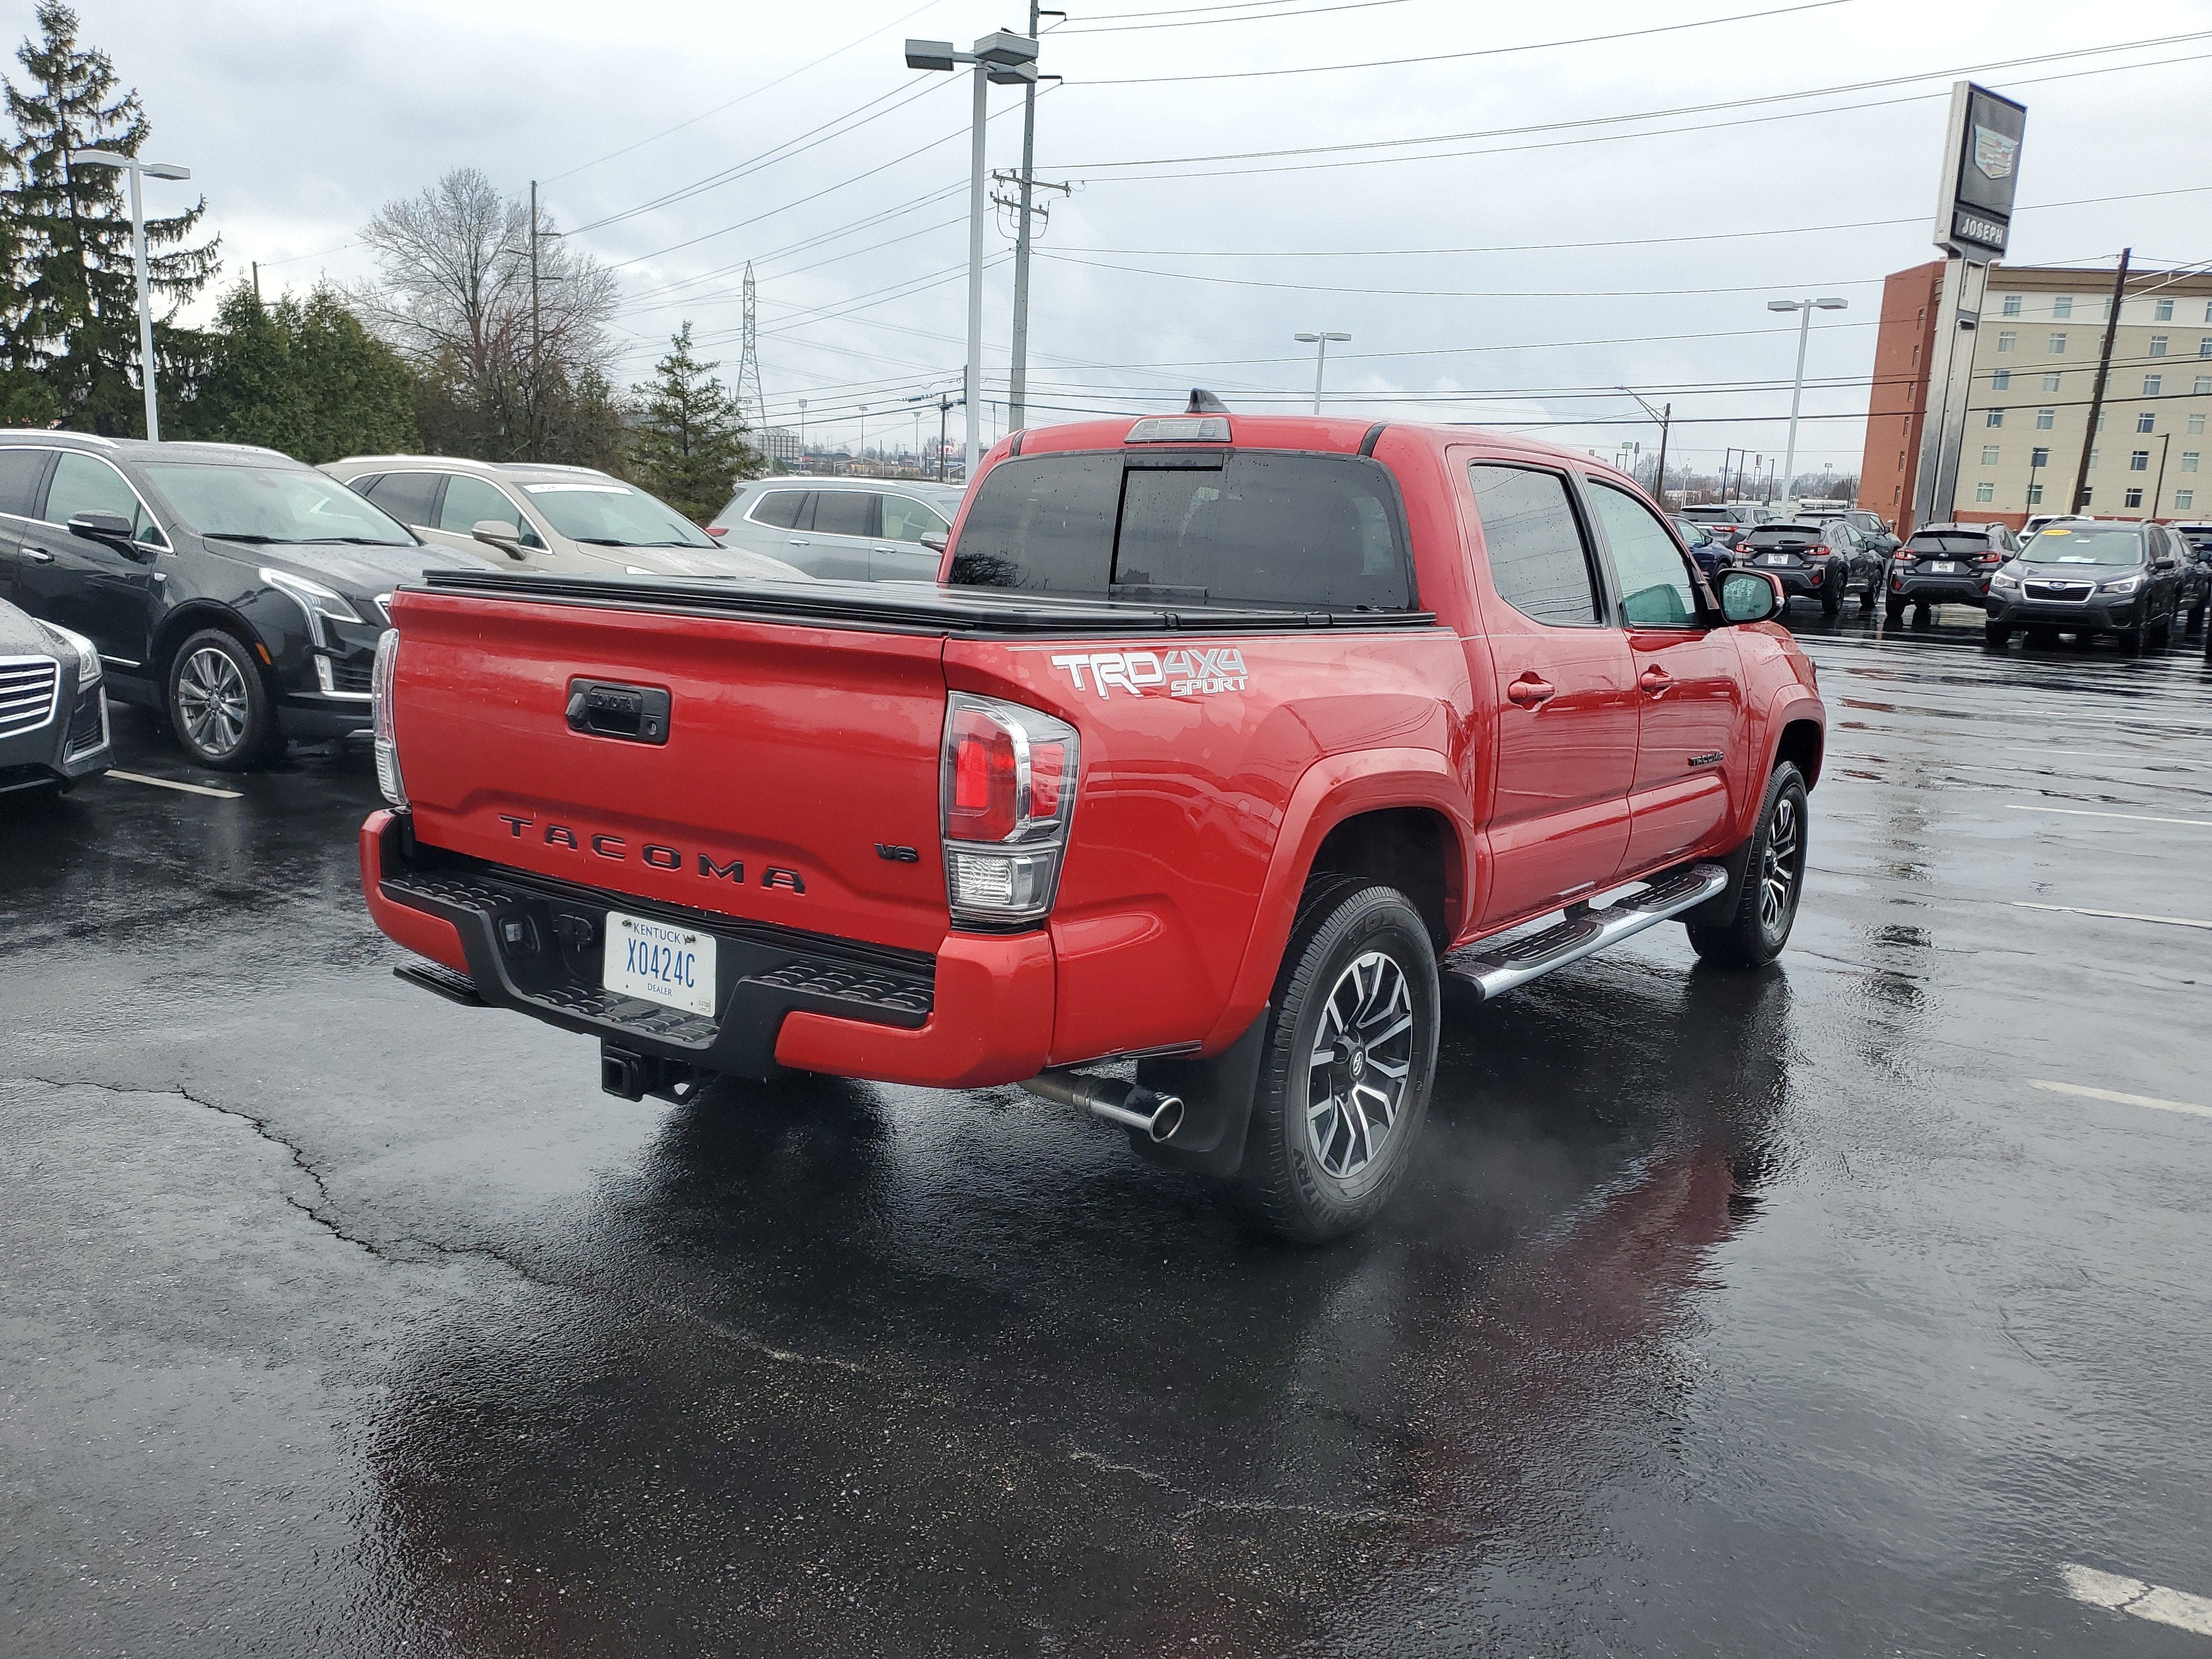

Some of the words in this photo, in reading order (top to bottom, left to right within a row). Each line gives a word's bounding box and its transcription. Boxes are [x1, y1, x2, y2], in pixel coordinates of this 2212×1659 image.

[1962, 218, 2002, 245] JOSEPH
[1051, 652, 1166, 700] TRD
[1171, 676, 1249, 697] SPORT
[589, 692, 635, 712] TOYOTA
[1690, 751, 1724, 766] TACOMA
[499, 813, 806, 894] TACOMA
[874, 843, 919, 862] V6
[633, 922, 693, 945] KENTUCKY
[627, 938, 695, 988] X0424C
[647, 983, 672, 996] DEALER
